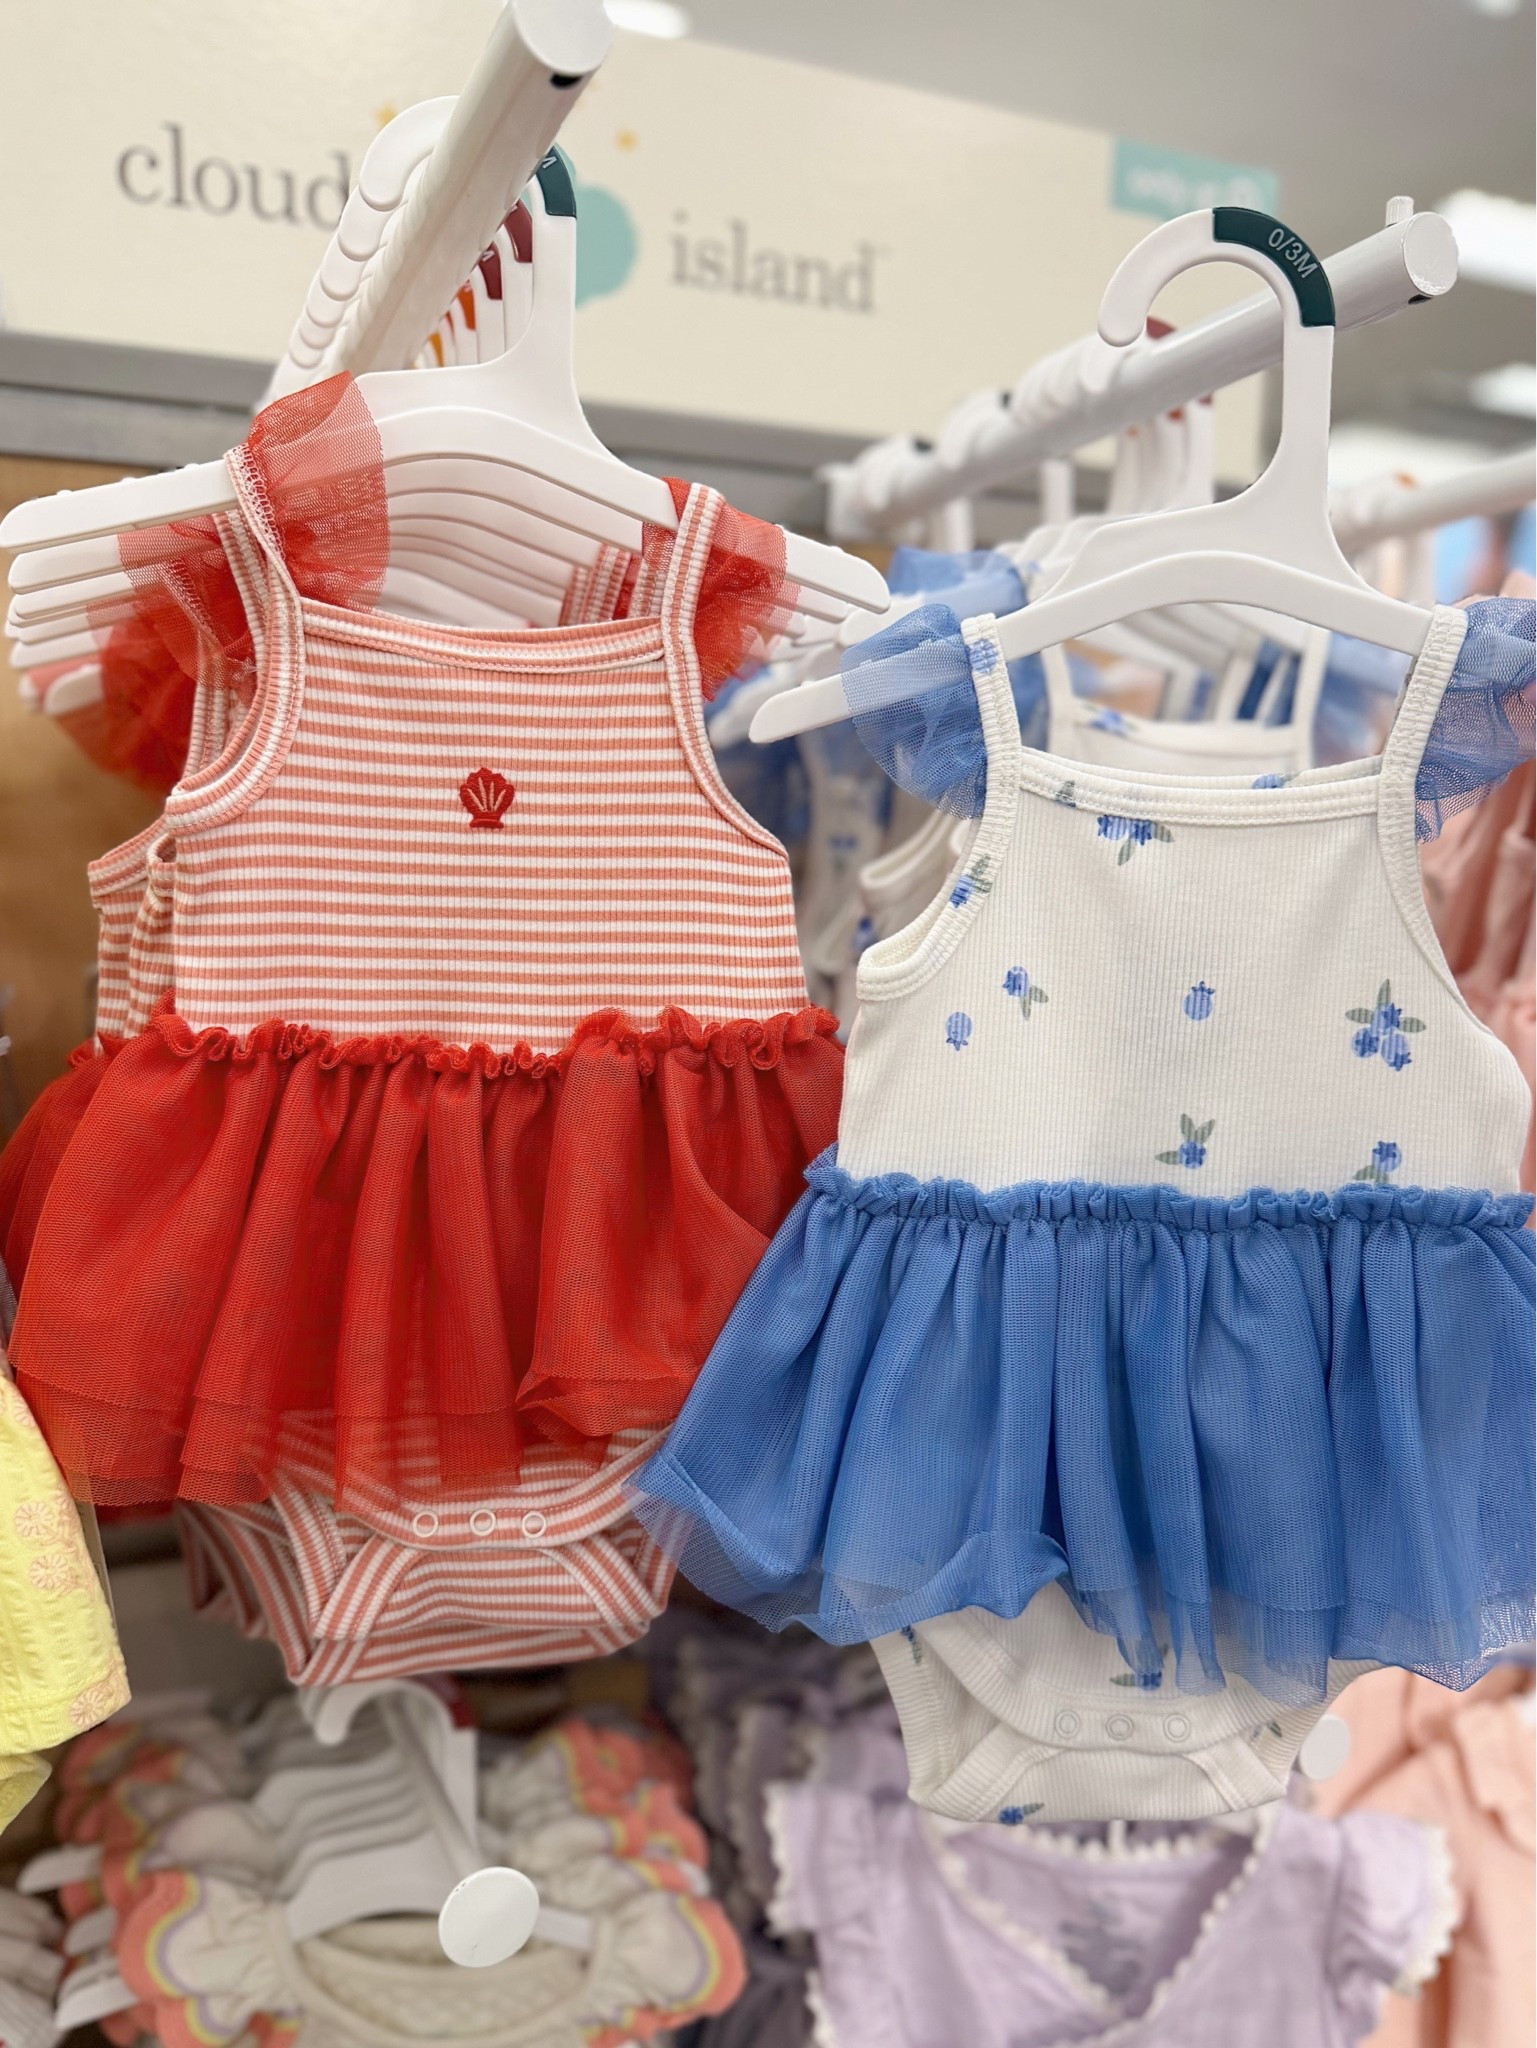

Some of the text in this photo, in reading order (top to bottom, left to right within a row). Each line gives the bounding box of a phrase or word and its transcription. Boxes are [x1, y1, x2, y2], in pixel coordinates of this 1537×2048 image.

[116, 121, 875, 314] cloud island
[1268, 228, 1318, 279] 0/3M
